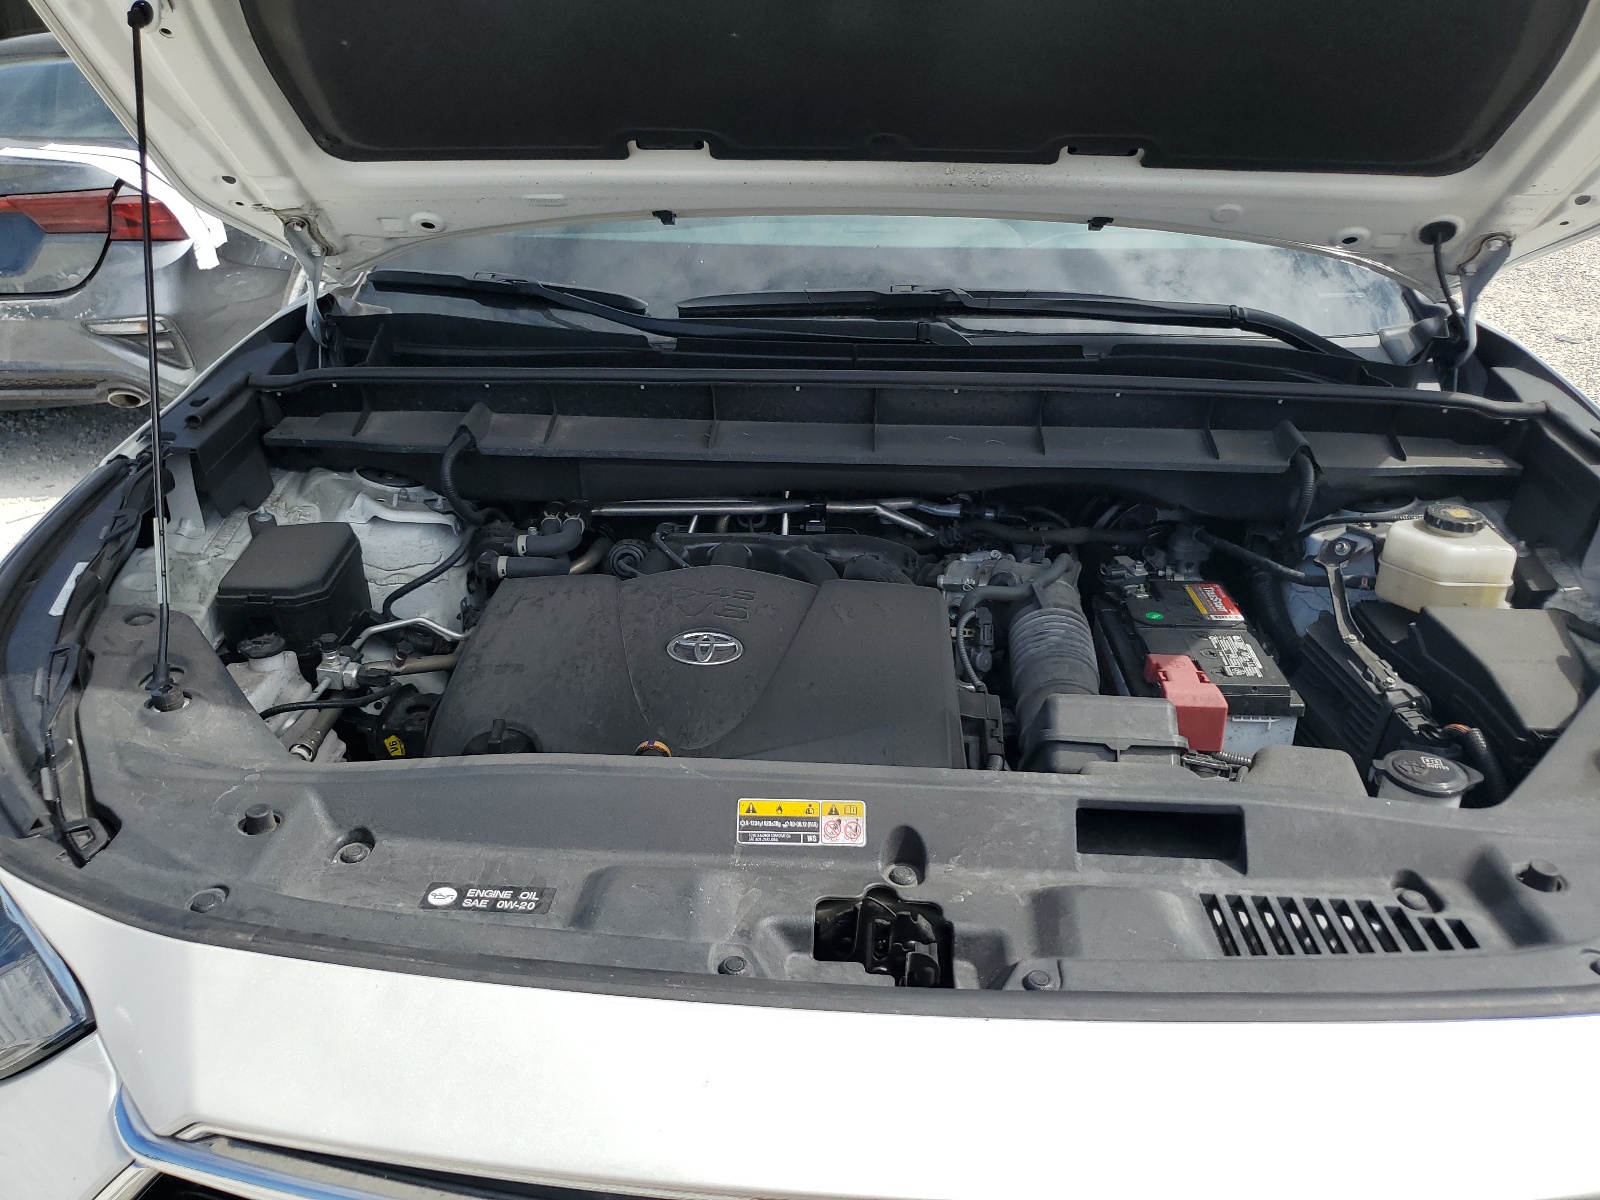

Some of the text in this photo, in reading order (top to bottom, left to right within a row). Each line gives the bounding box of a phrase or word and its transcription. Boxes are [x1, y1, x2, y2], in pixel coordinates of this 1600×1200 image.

[676, 600, 749, 621] V6
[389, 740, 399, 754] V6
[466, 888, 540, 900] ENGINE OIL
[462, 898, 536, 911] SAE 0W-20
